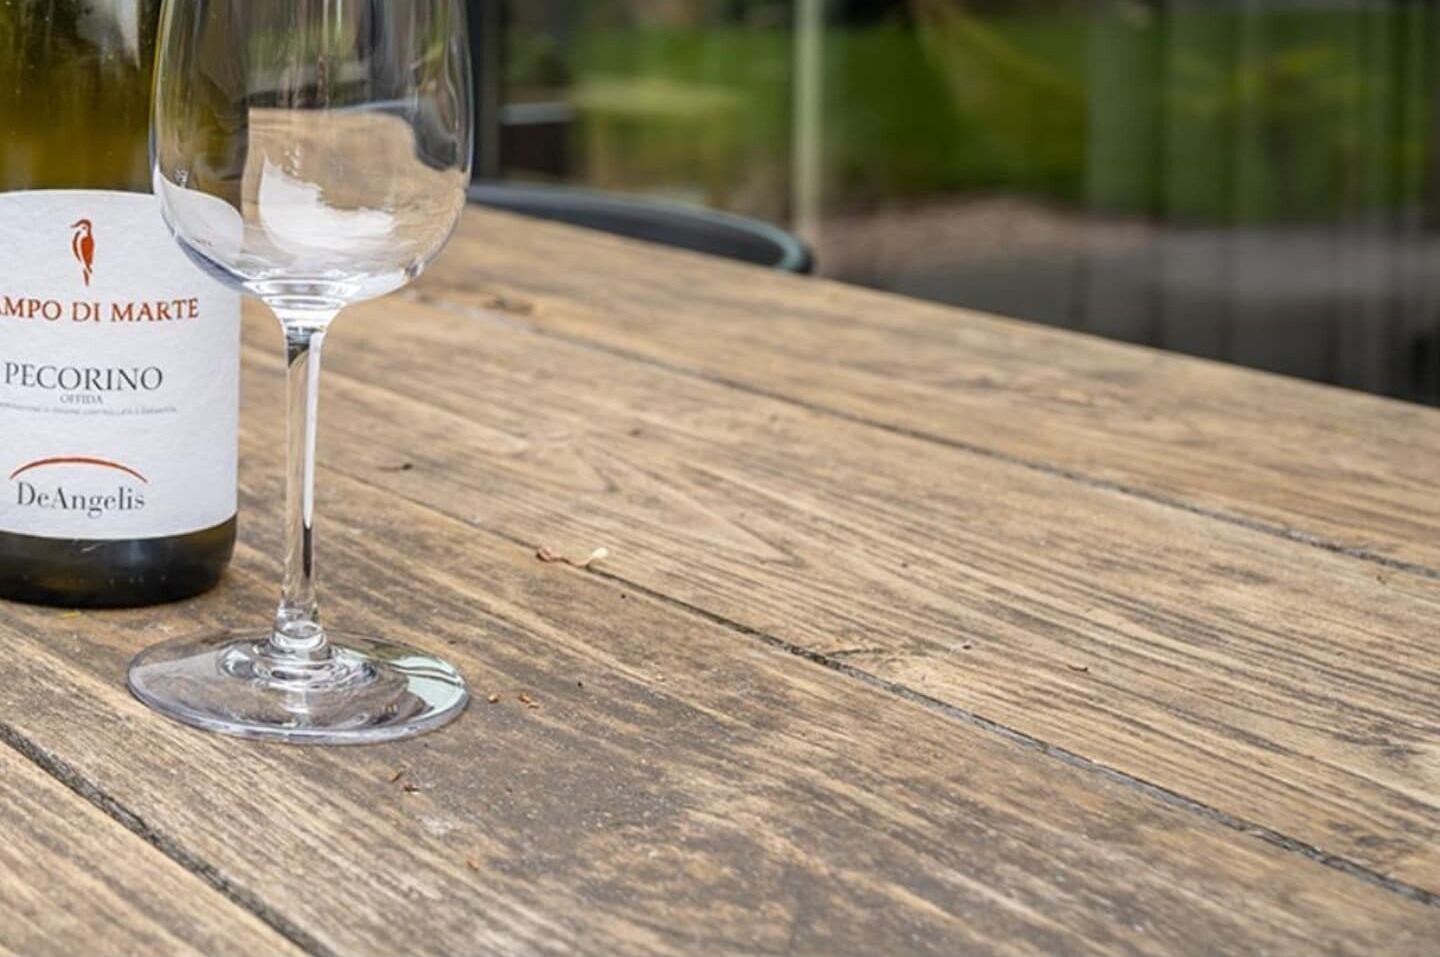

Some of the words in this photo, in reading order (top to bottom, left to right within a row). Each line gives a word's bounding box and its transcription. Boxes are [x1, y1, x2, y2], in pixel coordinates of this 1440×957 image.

[72, 301, 101, 323] DI
[111, 297, 200, 323] MARTE
[5, 361, 164, 392] PECORINO
[59, 394, 104, 406] OFFIDA
[17, 481, 146, 520] DeAngelis
